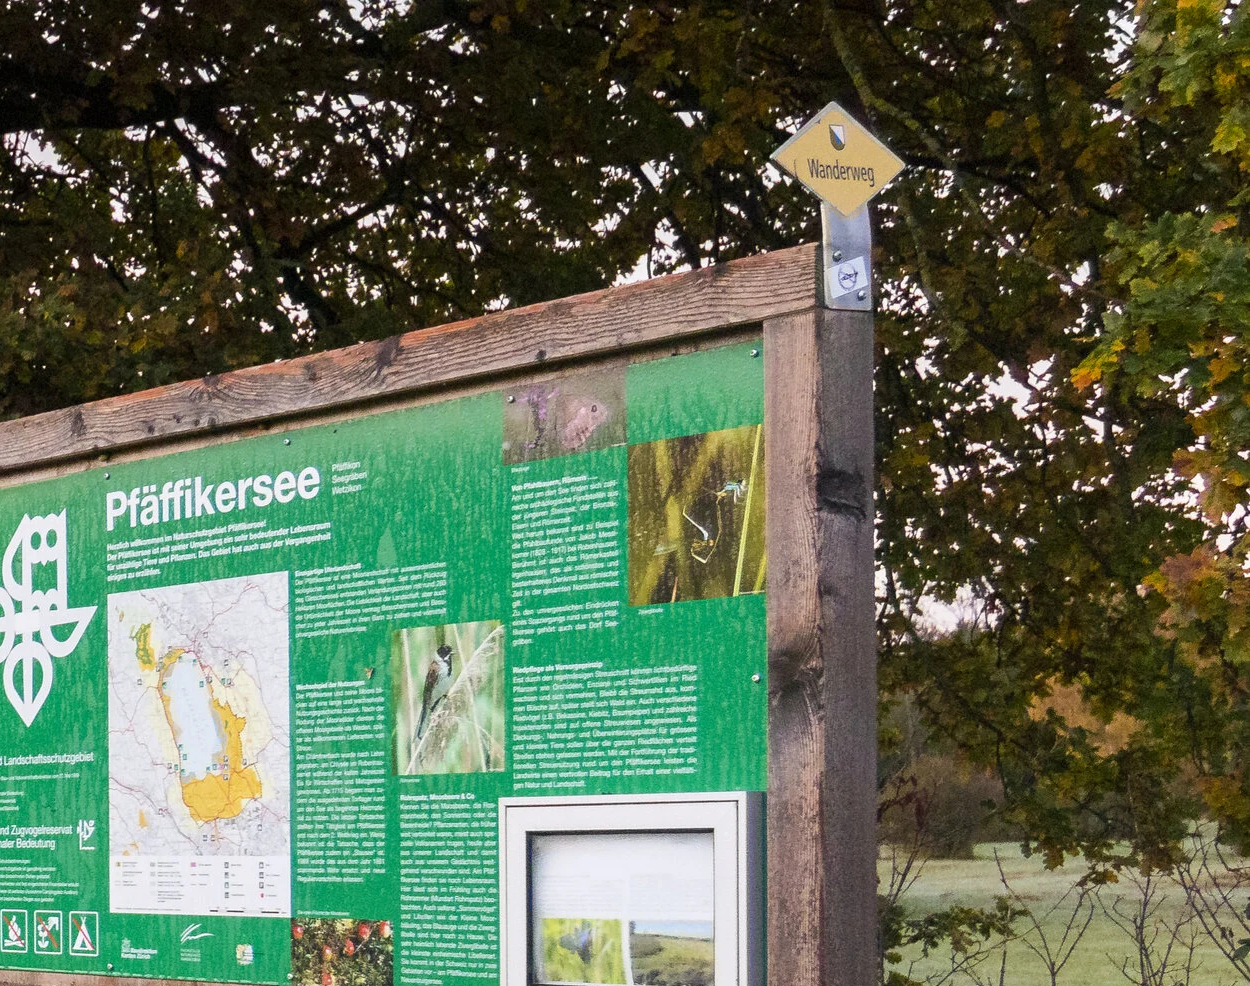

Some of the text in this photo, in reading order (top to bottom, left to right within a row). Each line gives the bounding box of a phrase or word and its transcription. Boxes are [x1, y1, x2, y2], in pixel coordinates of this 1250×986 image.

[807, 158, 875, 187] Wanderweg
[106, 466, 321, 531] Pfäffikersee
[4, 752, 94, 767] Landschaftsschutzgebiet
[11, 825, 72, 837] Zugvogelreservat
[16, 838, 55, 850] Bedeutung
